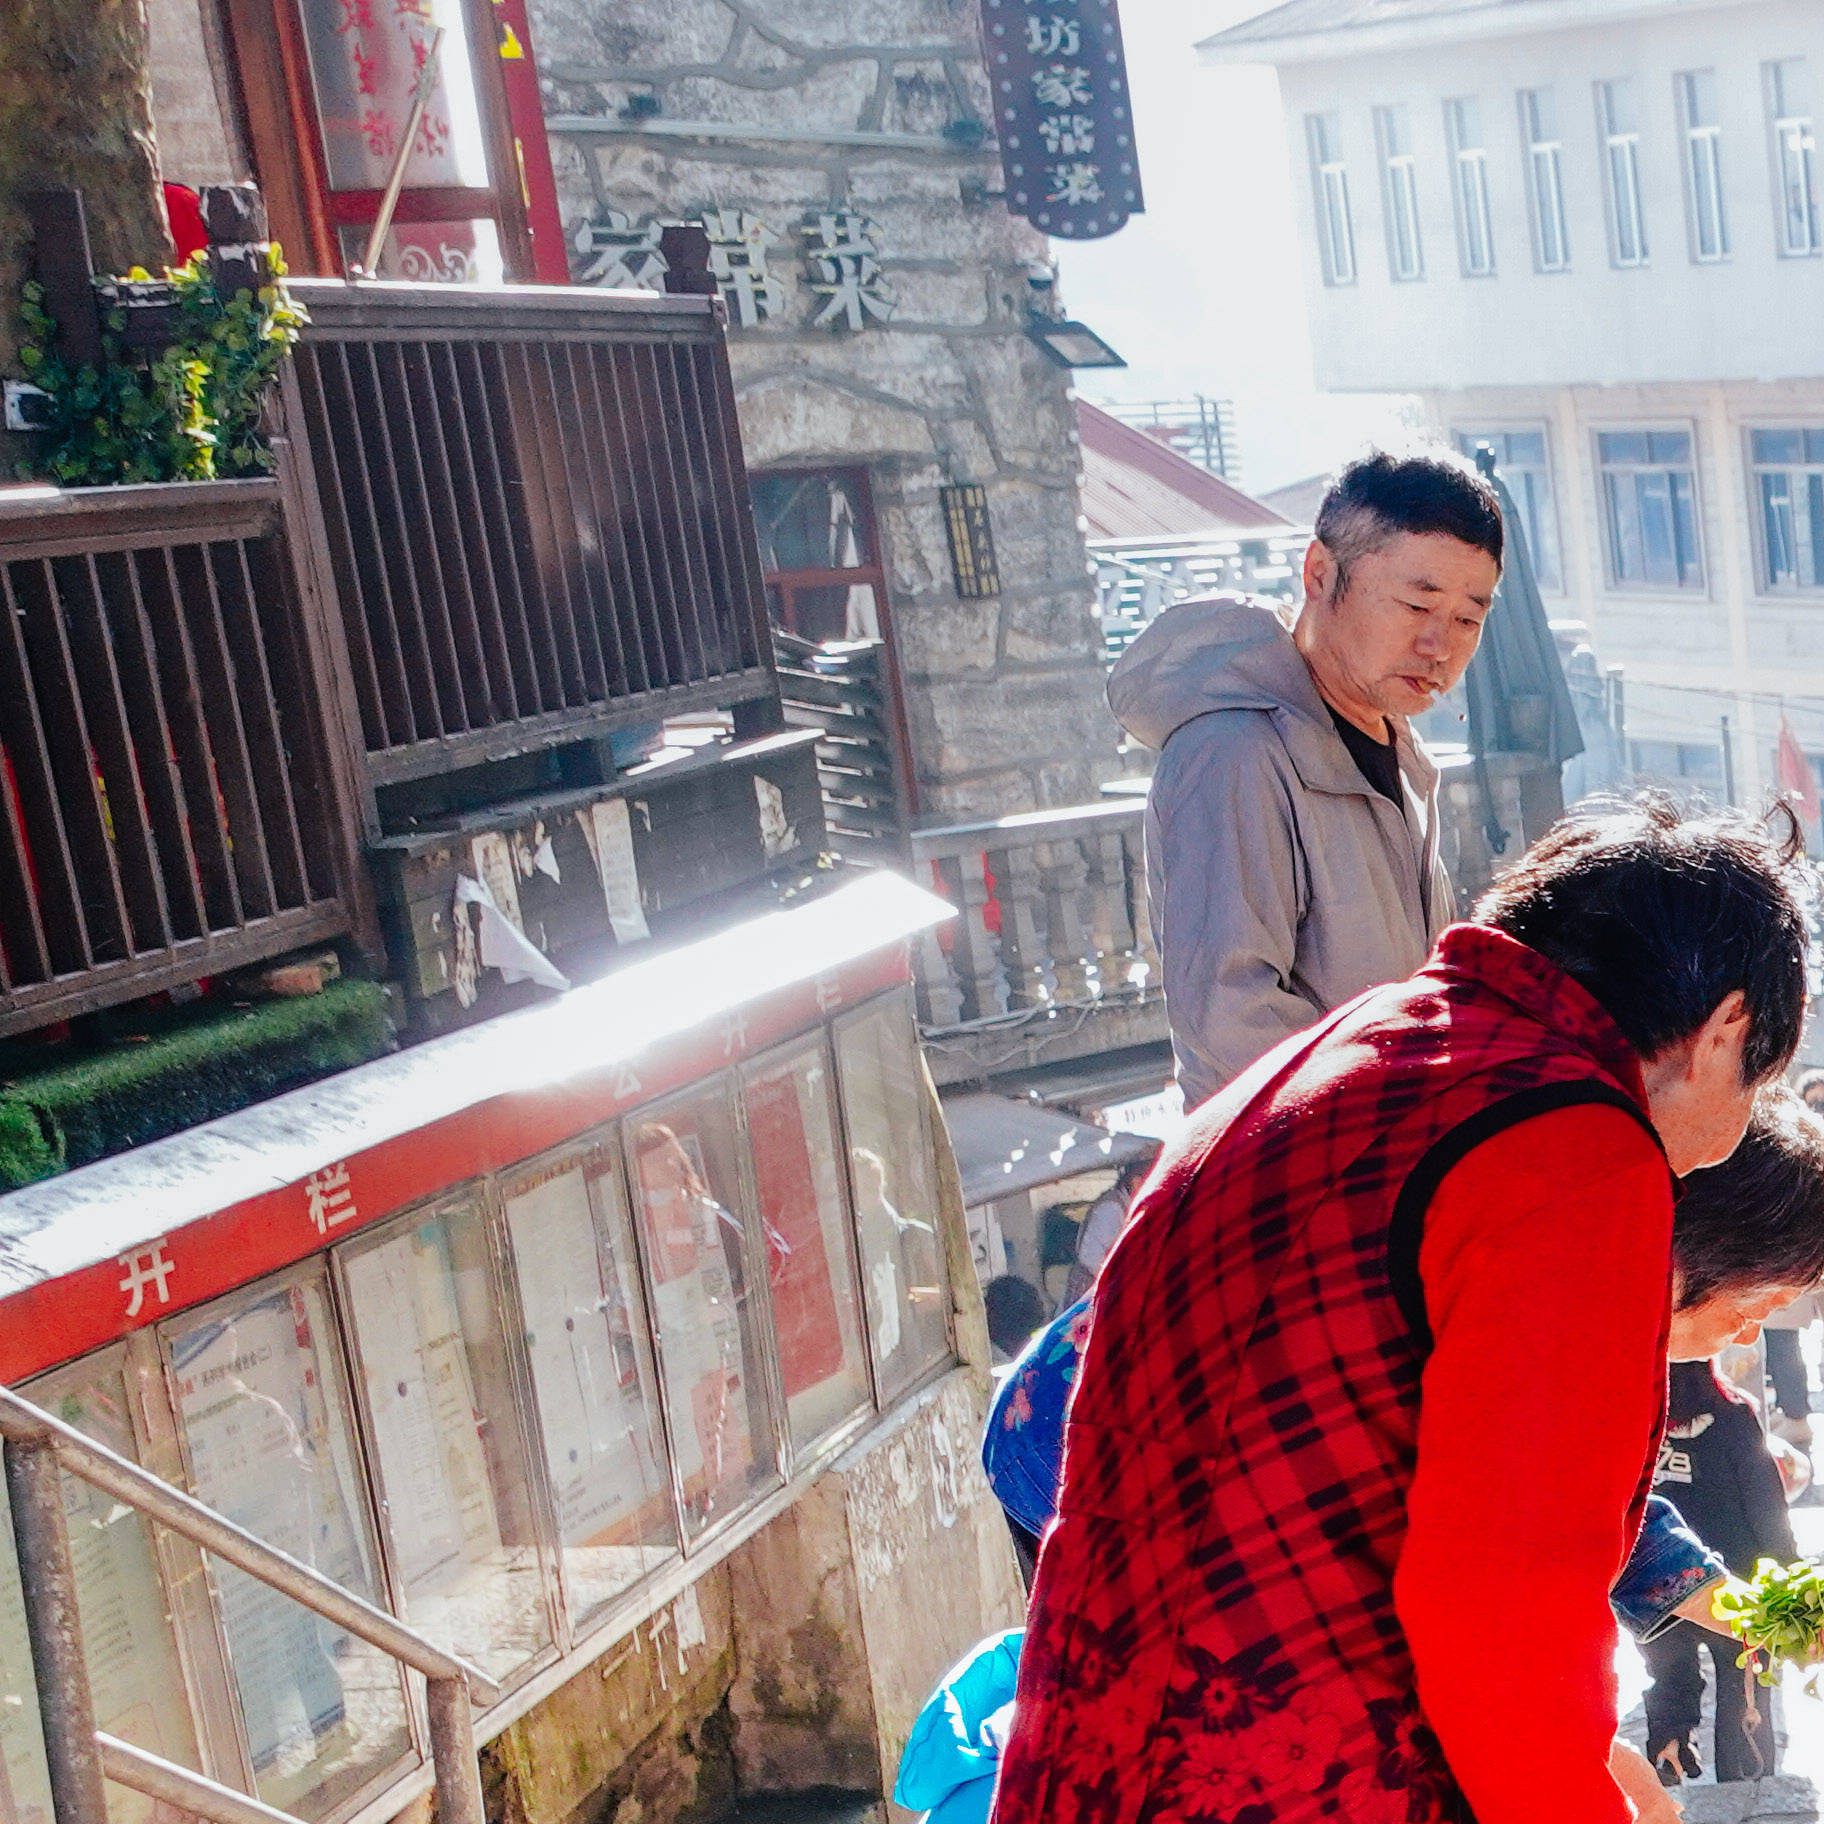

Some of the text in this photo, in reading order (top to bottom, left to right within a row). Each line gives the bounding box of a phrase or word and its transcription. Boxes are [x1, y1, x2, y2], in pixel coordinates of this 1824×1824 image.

[1022, 0, 1105, 206] 坊家常菜
[575, 208, 898, 331] 家常菜
